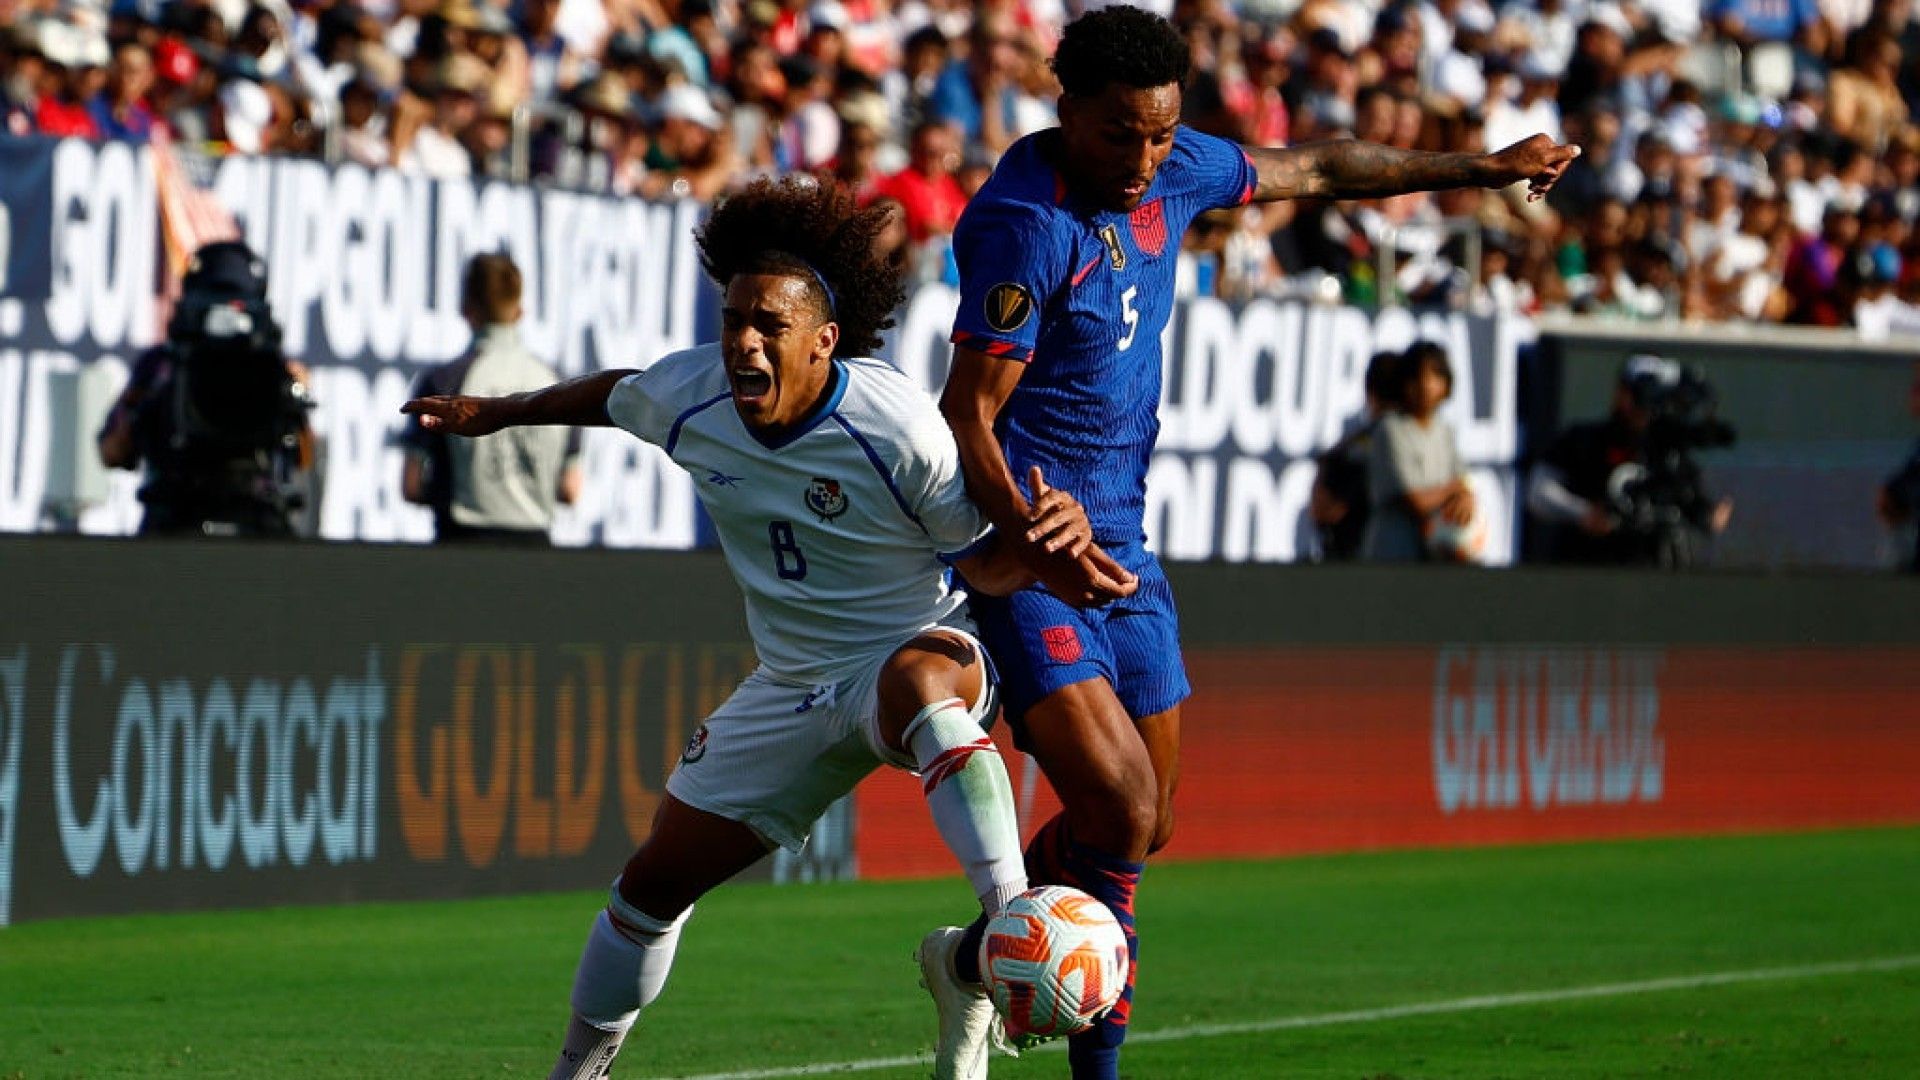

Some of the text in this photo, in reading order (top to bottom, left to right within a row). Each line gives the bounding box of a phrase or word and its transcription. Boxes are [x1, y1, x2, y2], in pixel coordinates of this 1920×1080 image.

[1130, 199, 1163, 226] USA
[1117, 284, 1139, 351] 5
[769, 520, 807, 581] 8
[1043, 627, 1078, 645] USA
[396, 646, 606, 868] GOLD
[1431, 645, 1666, 813] GATORADE
